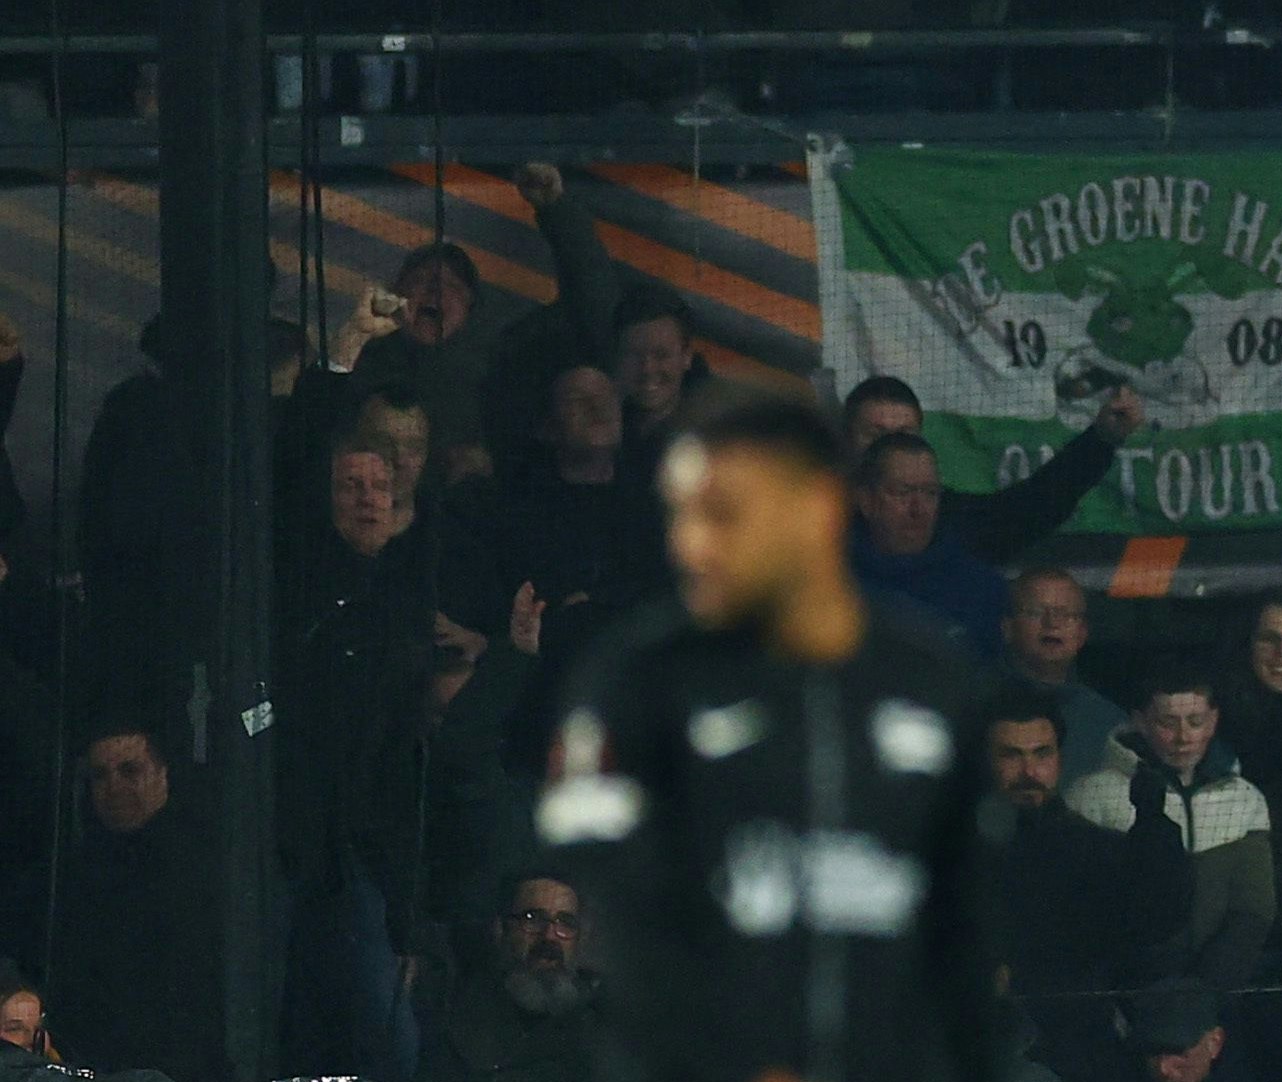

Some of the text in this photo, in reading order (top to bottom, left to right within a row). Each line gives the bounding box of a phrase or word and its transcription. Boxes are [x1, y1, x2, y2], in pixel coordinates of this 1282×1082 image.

[1008, 176, 1211, 275] GROENE
[1003, 318, 1048, 369] 19
[1116, 440, 1280, 522] TOUR
